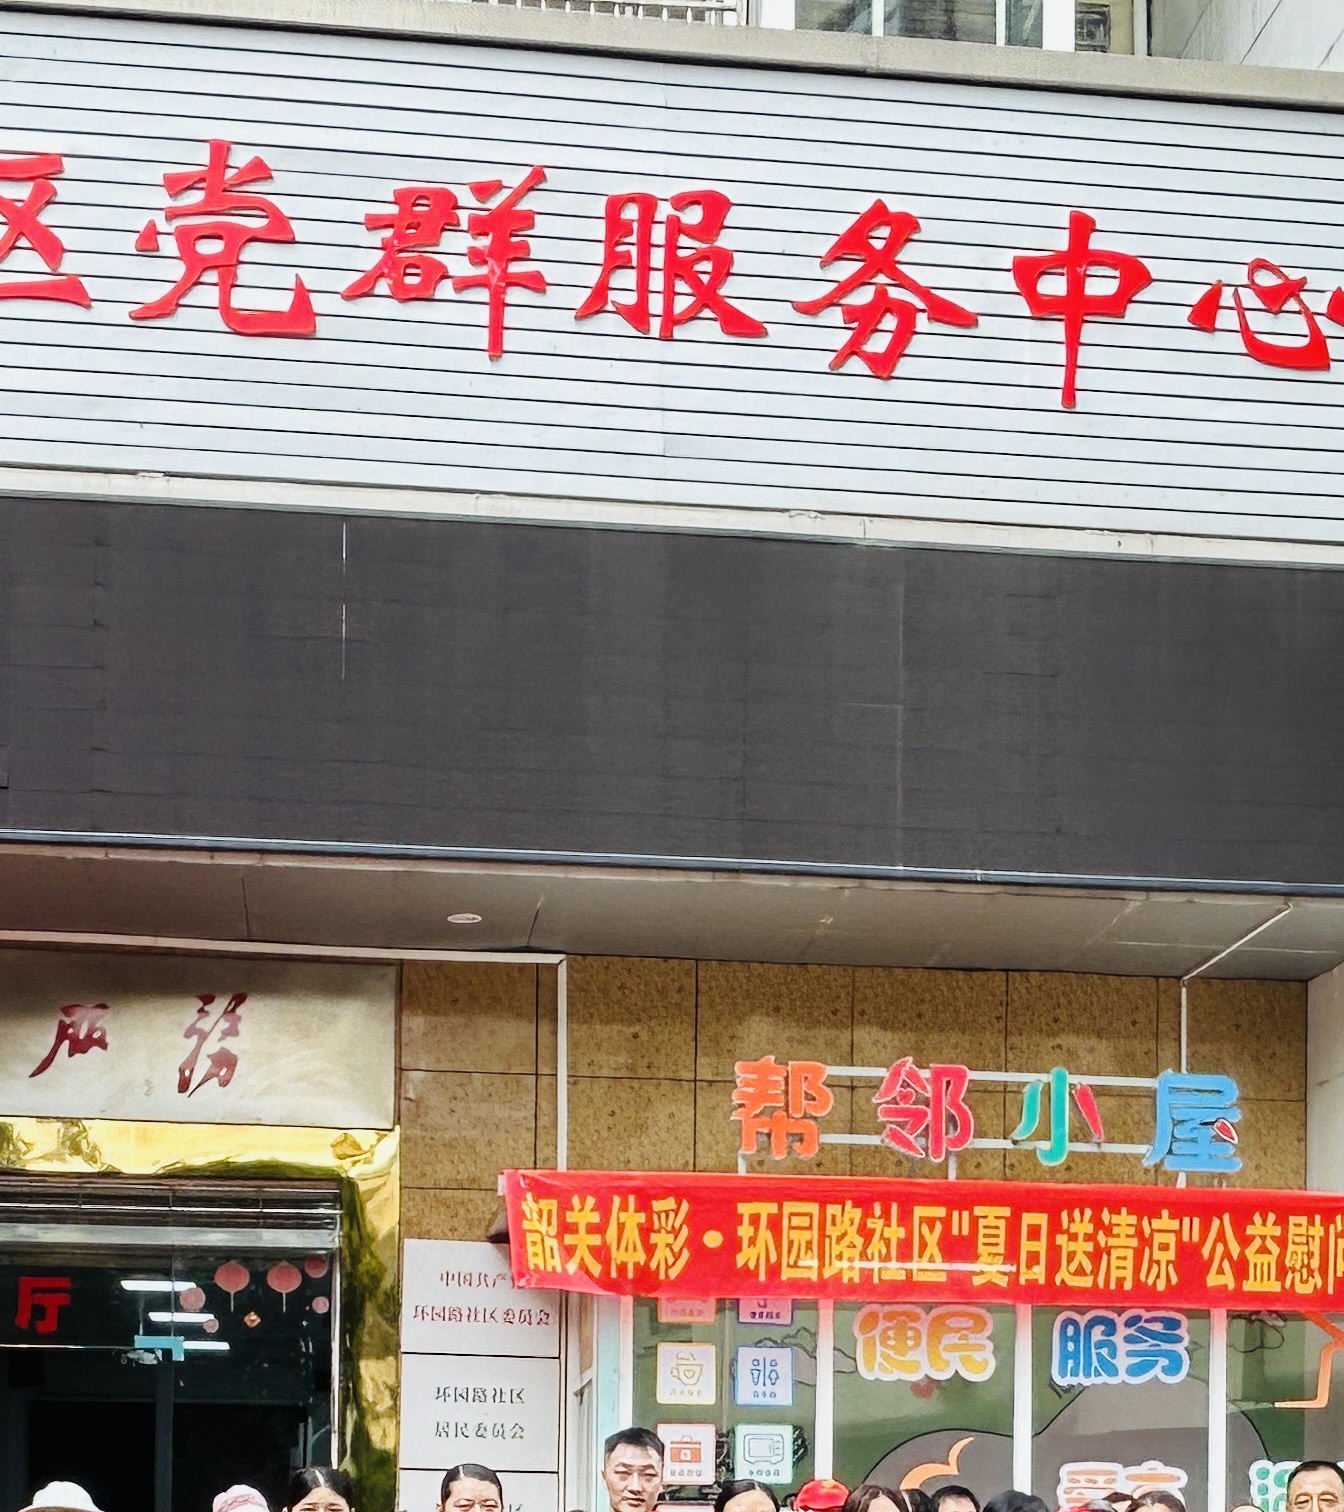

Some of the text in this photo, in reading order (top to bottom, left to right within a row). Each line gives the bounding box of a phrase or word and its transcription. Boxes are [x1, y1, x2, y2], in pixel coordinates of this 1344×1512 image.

[731, 1055, 1244, 1173] 帮邻小屋
[855, 1306, 1191, 1384] 便民 服务
